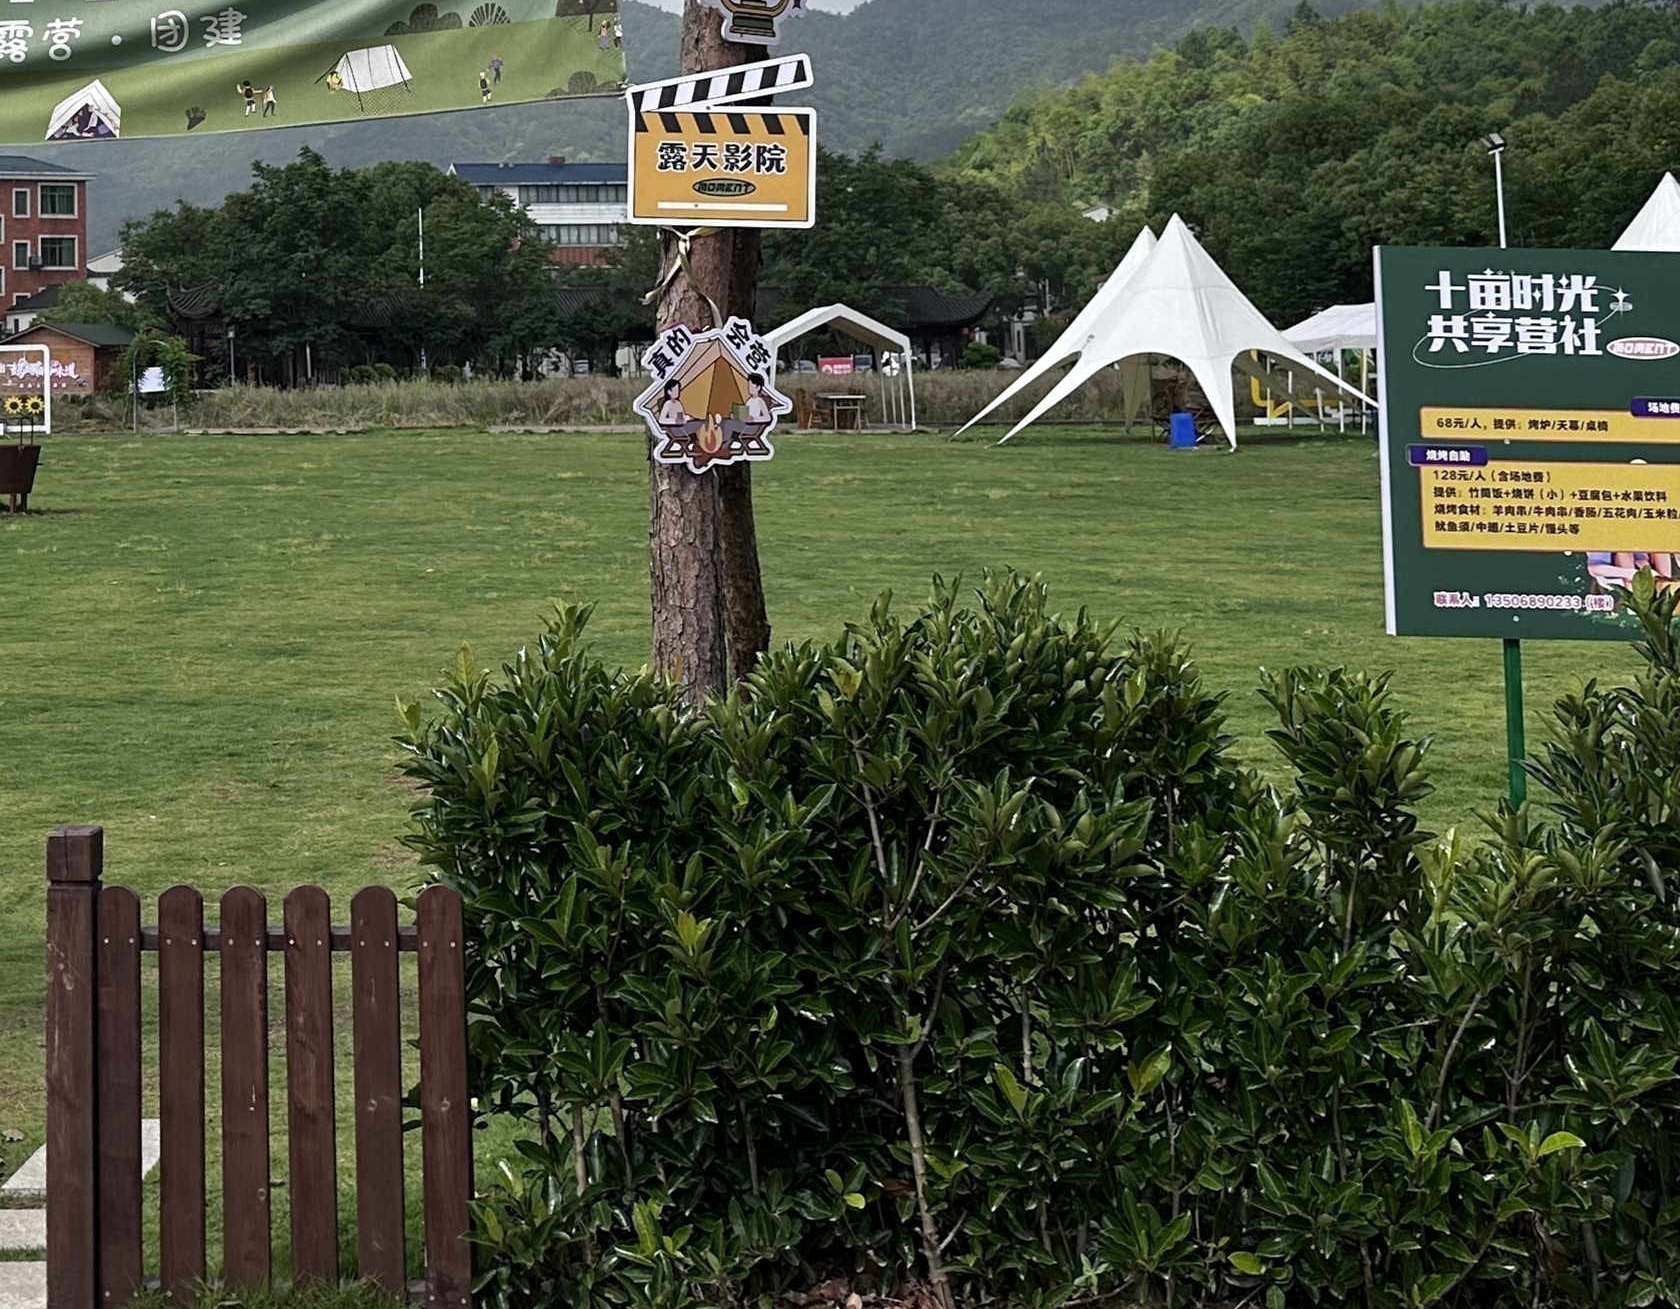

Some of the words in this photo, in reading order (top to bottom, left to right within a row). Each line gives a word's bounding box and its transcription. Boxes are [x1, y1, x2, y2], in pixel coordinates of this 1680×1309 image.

[657, 142, 786, 173] 露天影院
[1424, 269, 1600, 312] 十亩时光
[1427, 313, 1604, 355] 共享营社
